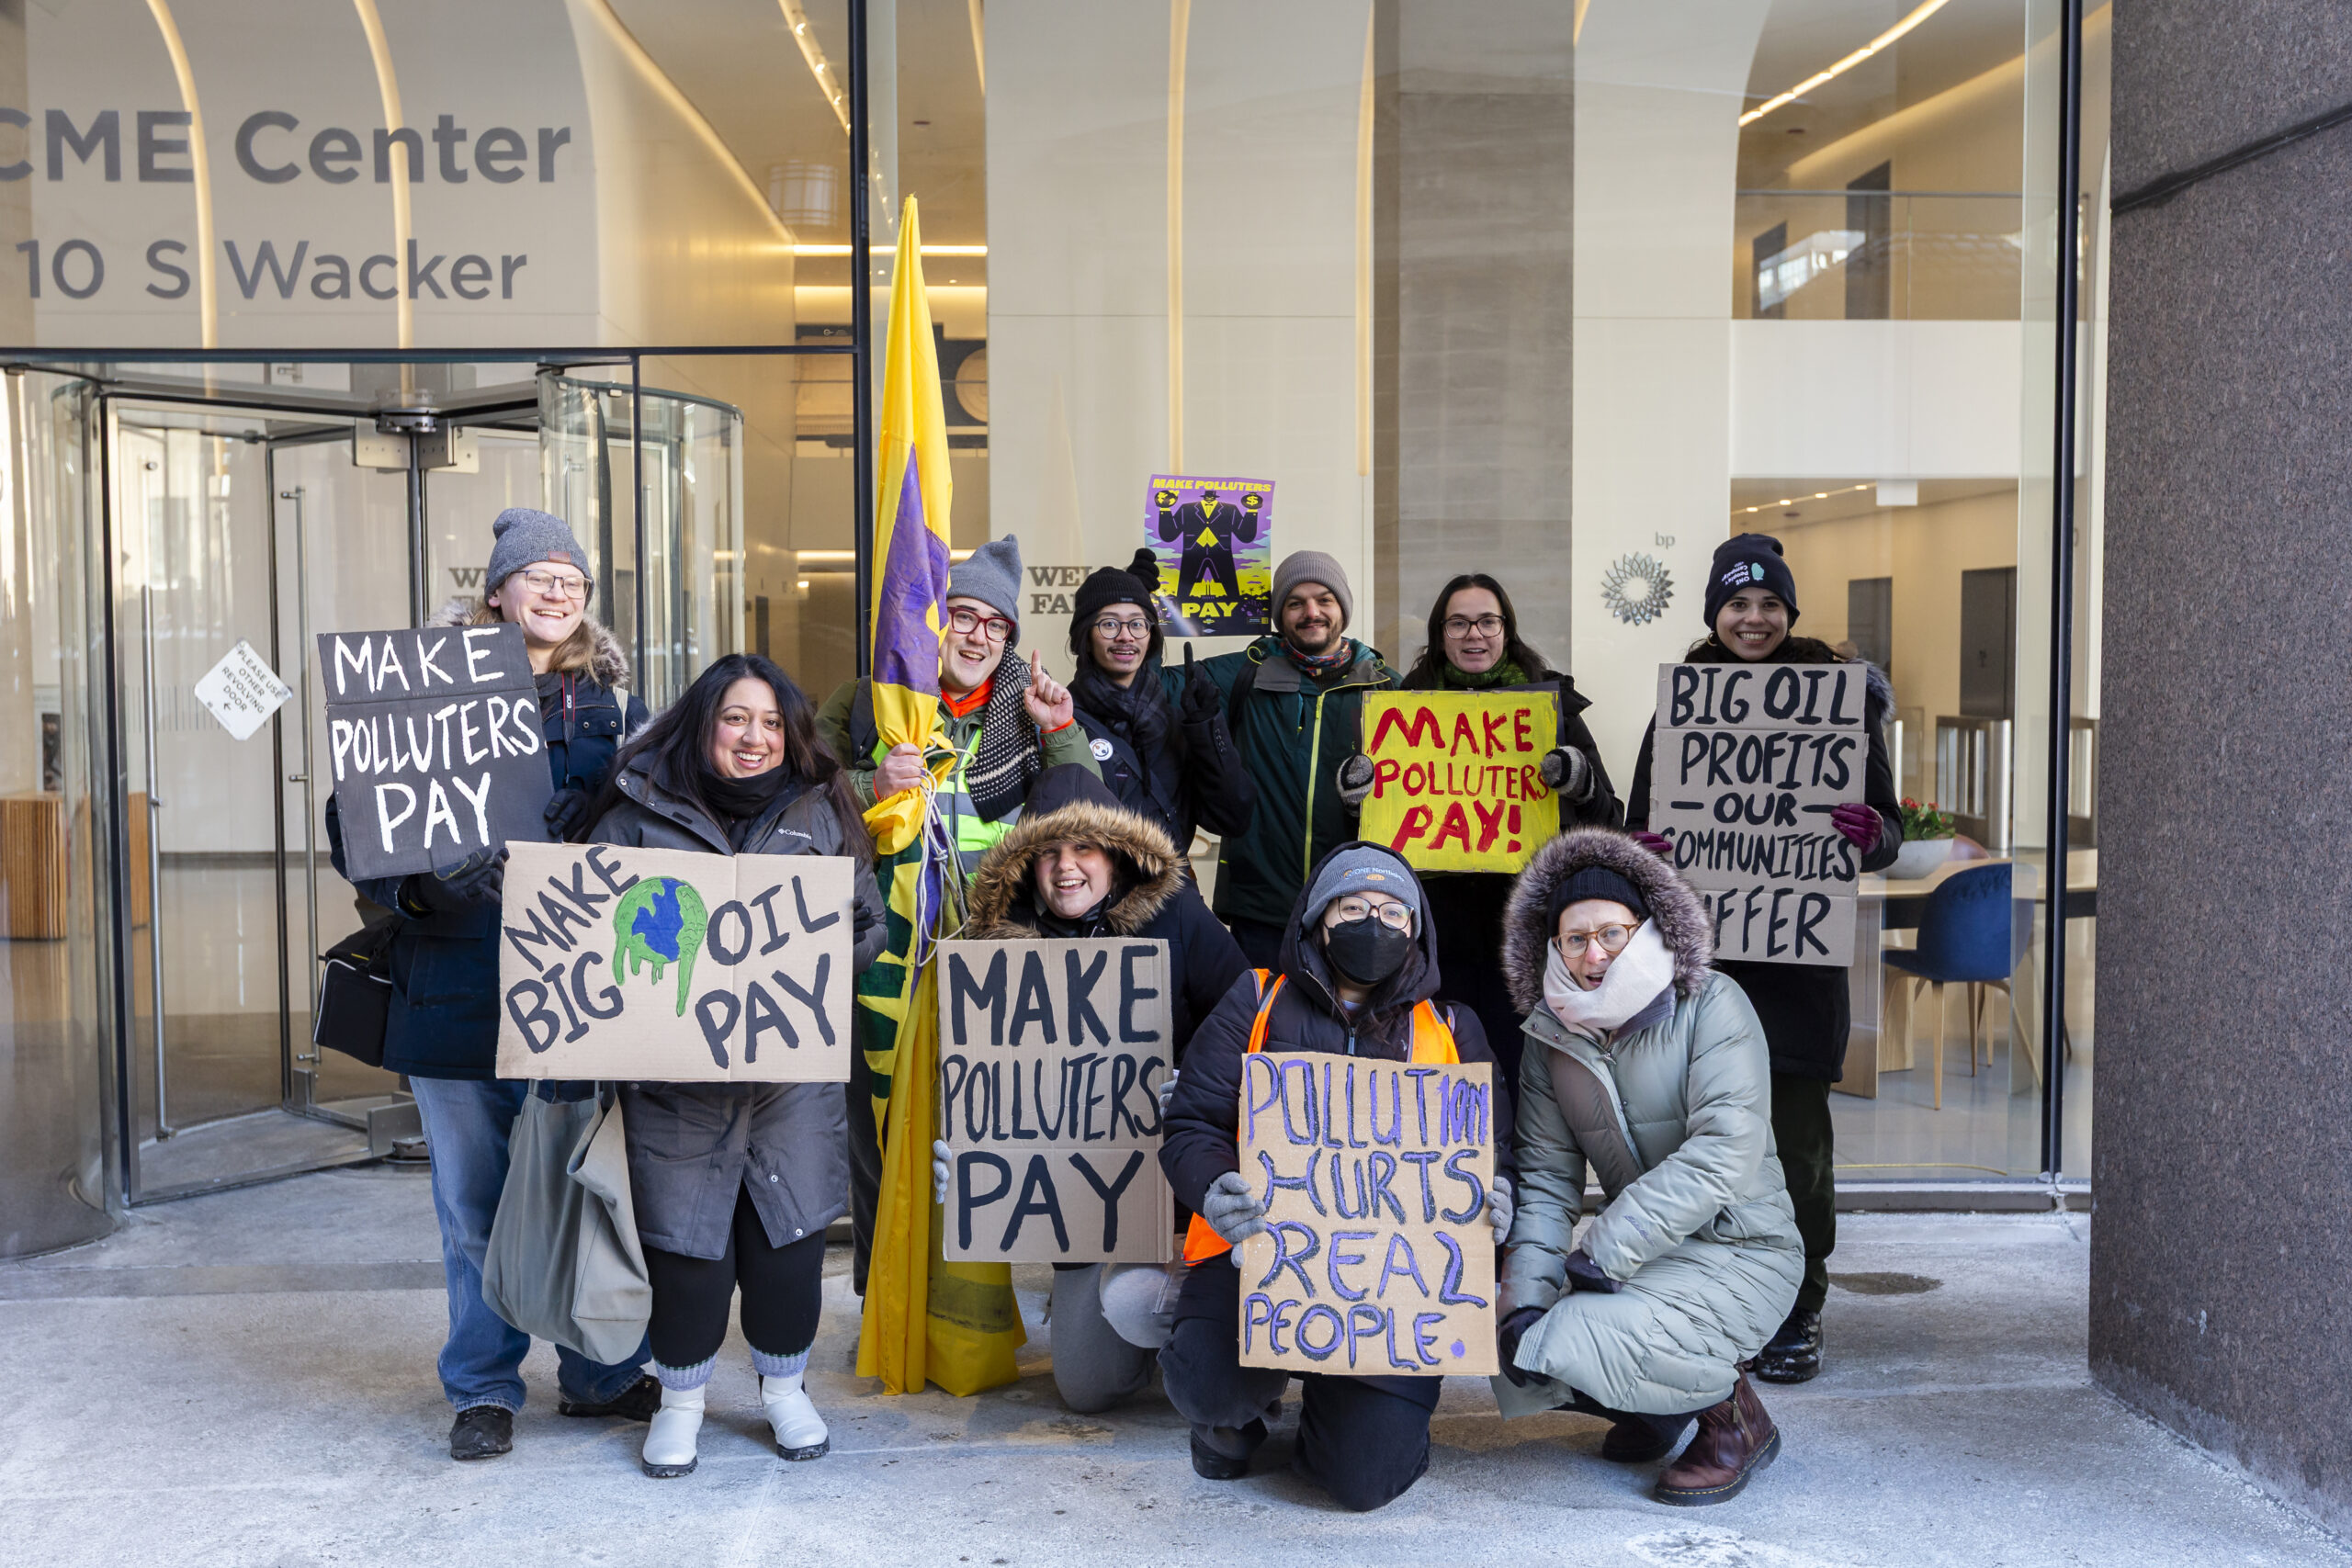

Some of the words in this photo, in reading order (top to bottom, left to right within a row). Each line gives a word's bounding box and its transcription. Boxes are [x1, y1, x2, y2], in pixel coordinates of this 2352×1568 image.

[235, 110, 571, 184] Center
[16, 239, 105, 299] 10
[145, 239, 191, 299] S
[223, 239, 527, 299] Wacker
[1152, 479, 1193, 490] MAKE
[1195, 480, 1272, 492] POLLUTERS
[1655, 531, 1676, 550] bp
[1182, 602, 1238, 618] PAY
[221, 666, 265, 714] REVOLVING
[237, 649, 267, 682] PLEASE
[266, 681, 282, 699] USE
[239, 668, 265, 696] OTHER
[334, 627, 504, 695] MAKE
[1670, 665, 1753, 727] BIG
[1763, 666, 1860, 725] OIL
[223, 684, 247, 712] DOOR
[1367, 706, 1534, 759] MAKE
[332, 696, 539, 781] POLLUTERS
[1681, 731, 1856, 791] PROFITS
[374, 772, 491, 853] PAY
[1373, 759, 1550, 802] POLLUTERS
[1390, 798, 1522, 854] PAY!
[503, 846, 640, 971] MAKE
[707, 874, 841, 965] OIL
[1704, 886, 1831, 959] FFER
[506, 951, 624, 1054] BIG
[695, 953, 836, 1069] PAY
[948, 944, 1160, 1047] MAKE
[942, 1053, 1165, 1144] POLLUTERS
[1245, 1054, 1490, 1148] POLLUTION
[957, 1149, 1145, 1253] PAY
[1258, 1148, 1485, 1226] HURTS
[1258, 1221, 1488, 1309] REAL
